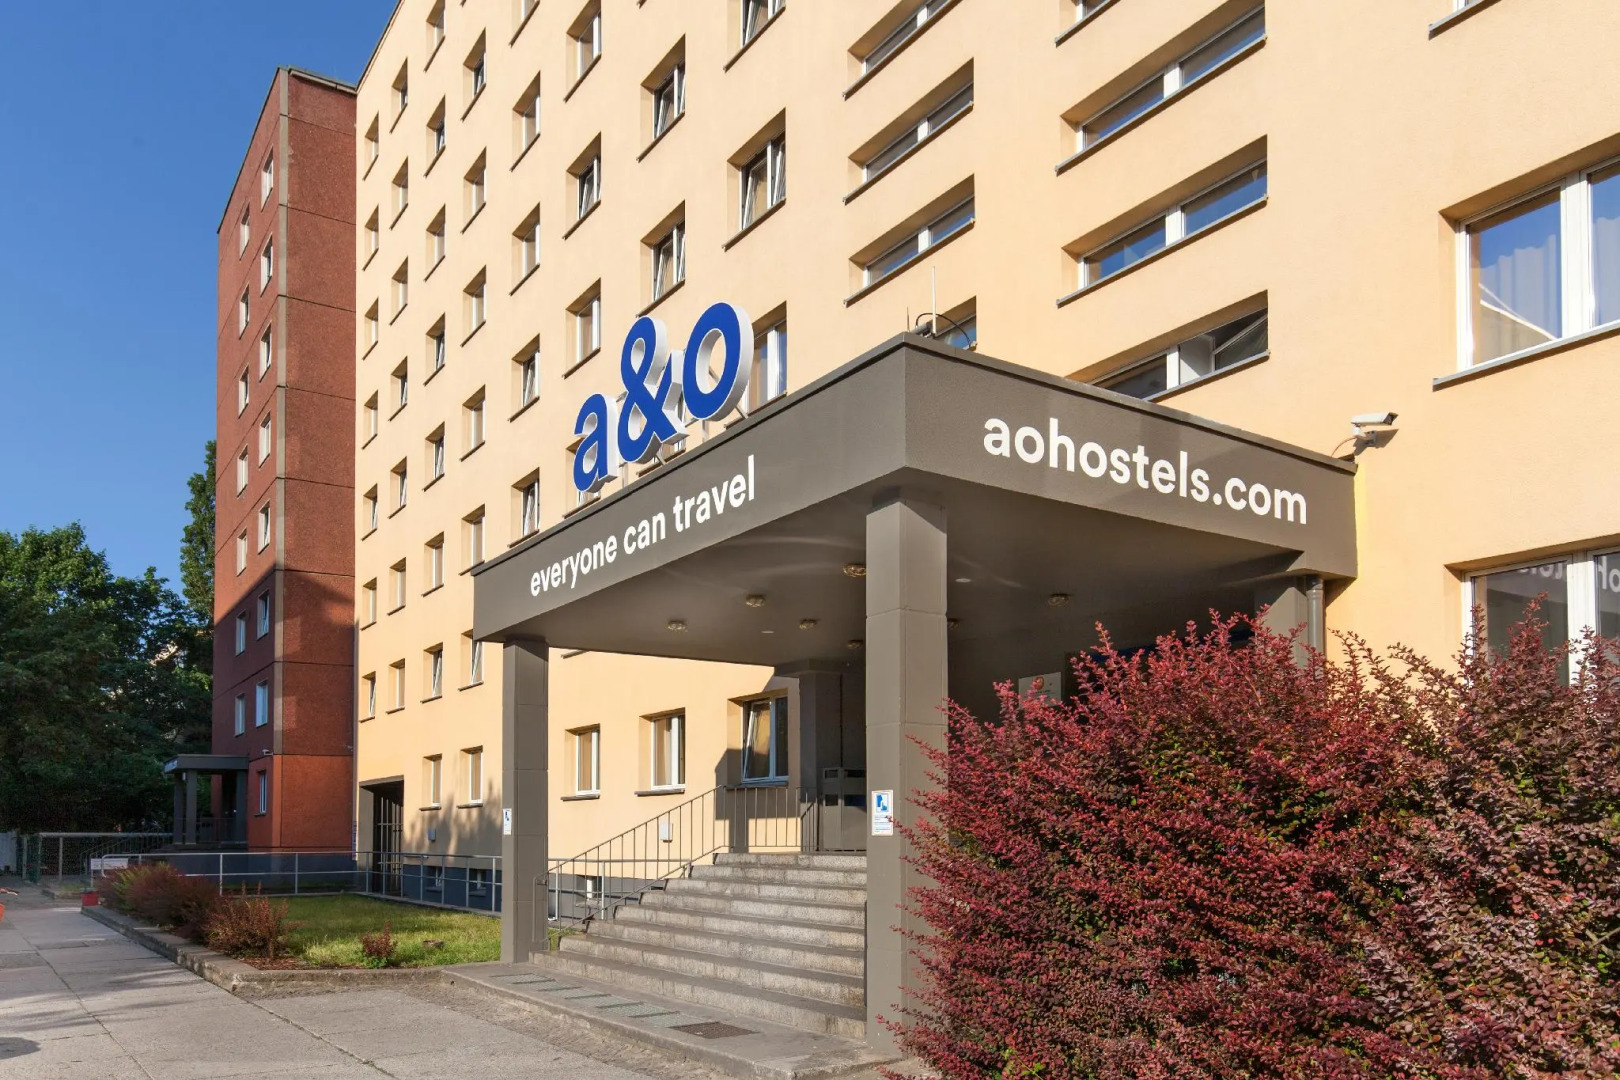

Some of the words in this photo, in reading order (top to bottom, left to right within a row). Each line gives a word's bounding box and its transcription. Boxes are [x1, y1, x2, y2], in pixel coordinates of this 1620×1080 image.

[573, 302, 751, 493] a&o
[530, 535, 618, 597] everyone
[623, 512, 666, 555] can
[672, 454, 755, 533] travel
[983, 417, 1307, 525] aohostels.com
